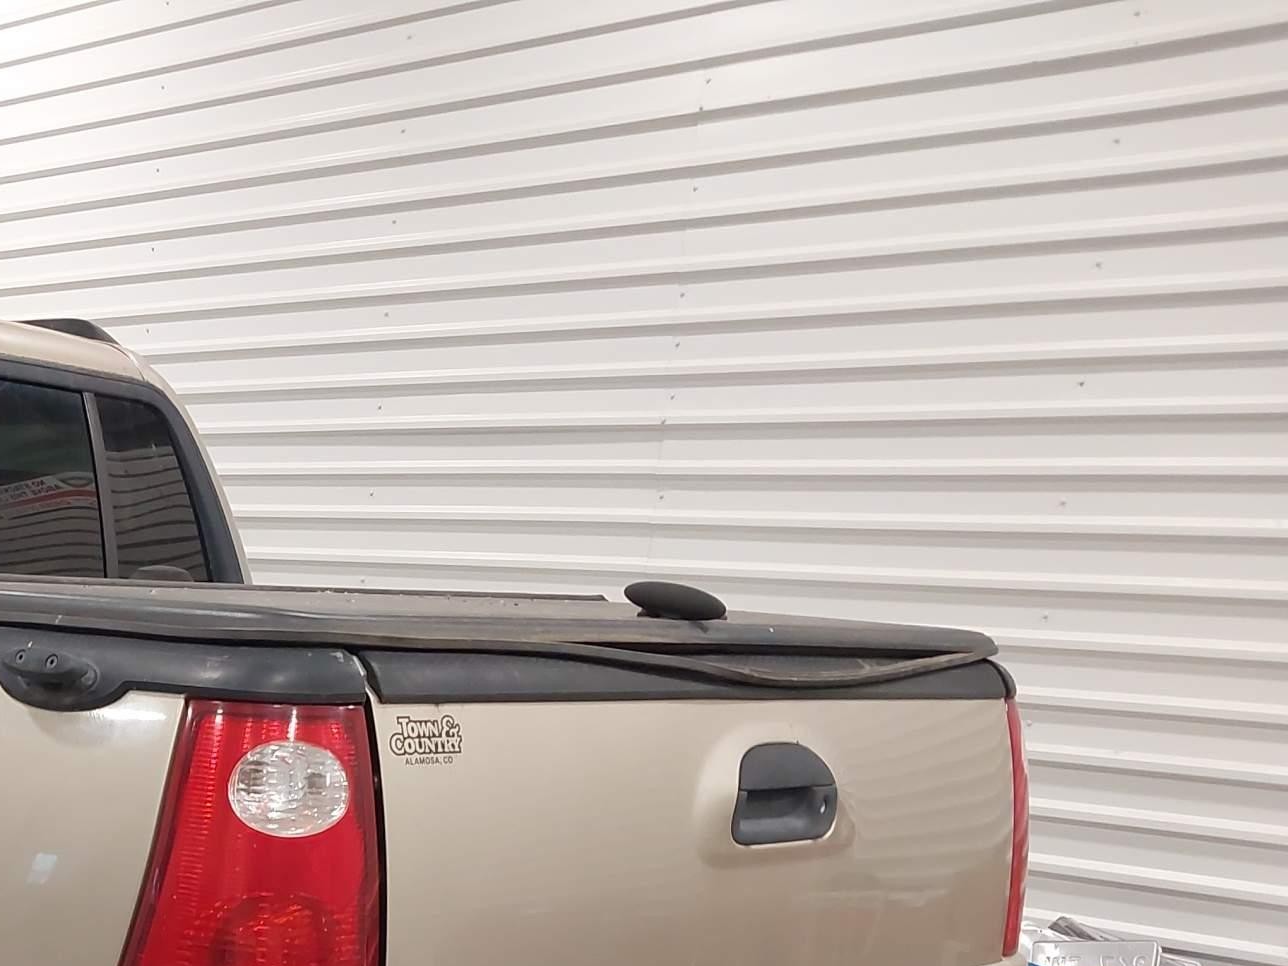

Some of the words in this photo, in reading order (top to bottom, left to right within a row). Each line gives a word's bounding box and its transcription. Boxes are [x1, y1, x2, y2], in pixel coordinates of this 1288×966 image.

[396, 716, 440, 738] TOWN
[440, 714, 461, 739] &
[389, 733, 462, 756] COUNTRY
[443, 756, 454, 765] CO
